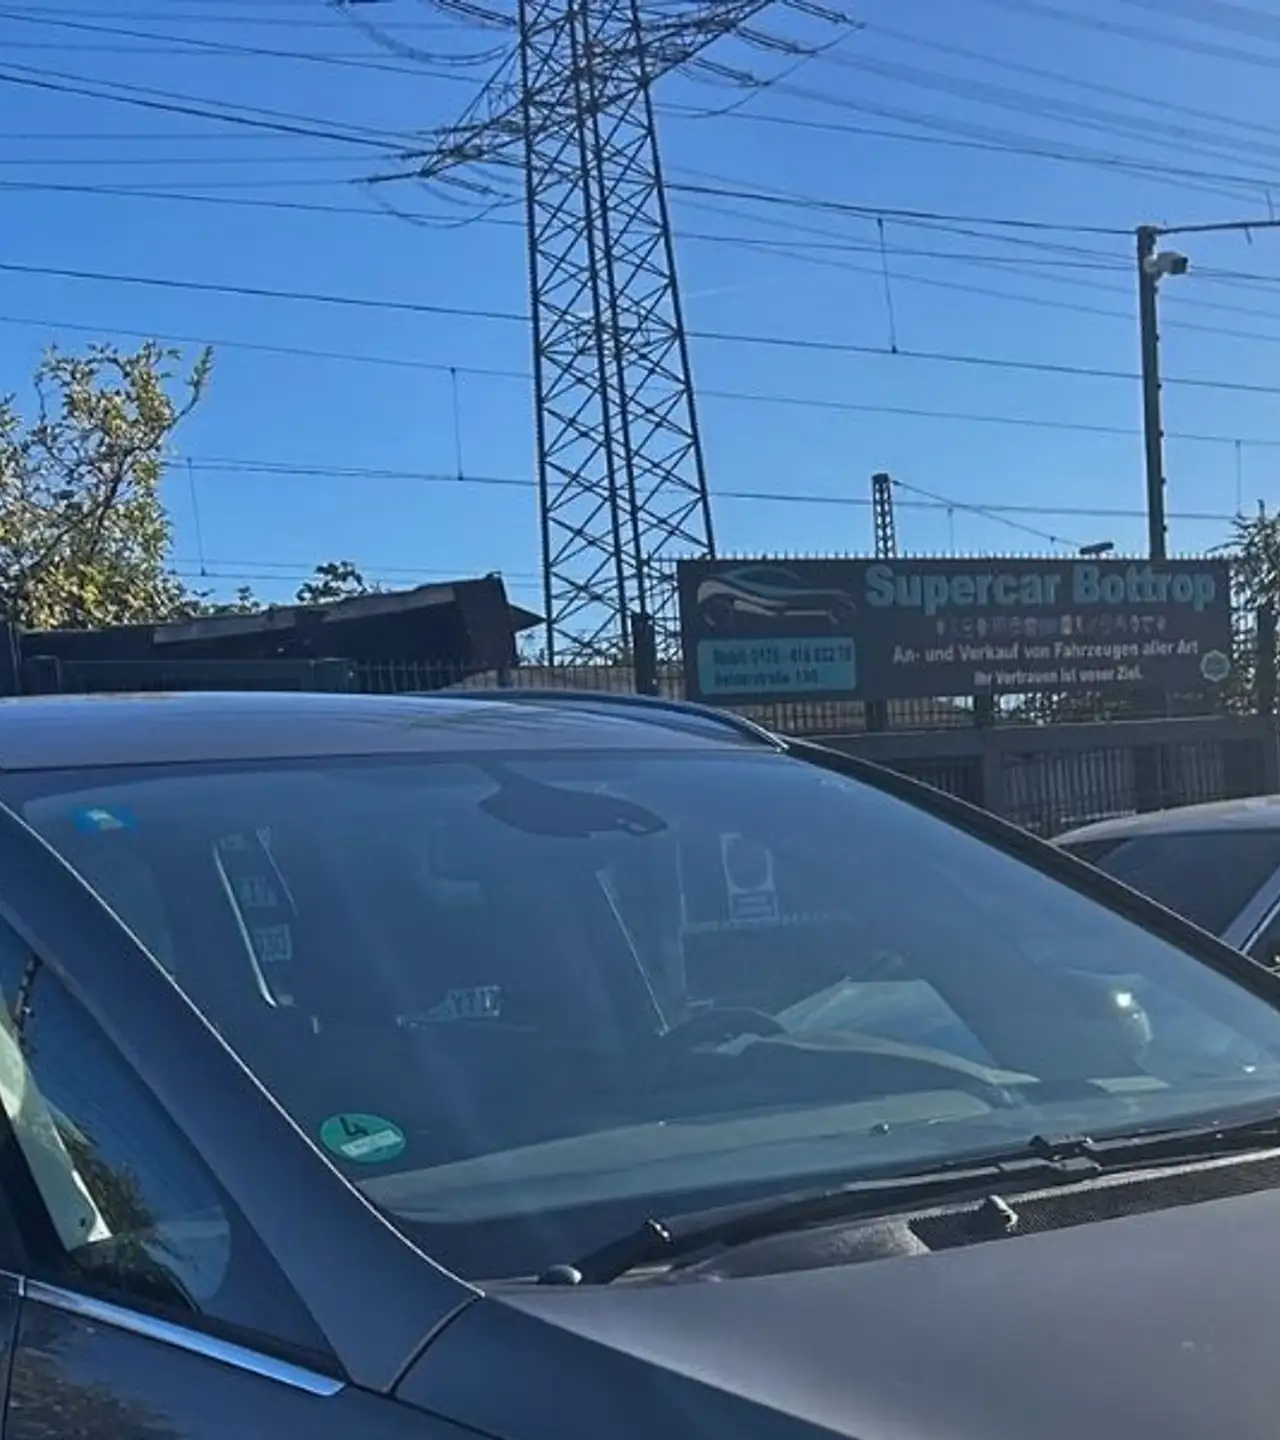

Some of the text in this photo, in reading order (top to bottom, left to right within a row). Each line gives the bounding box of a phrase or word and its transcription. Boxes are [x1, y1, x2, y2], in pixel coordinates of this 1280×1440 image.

[865, 562, 1215, 615] Supercar Bottrop
[925, 644, 954, 662] und
[959, 642, 1019, 661] Verkauf
[1024, 645, 1049, 659] von
[1054, 641, 1138, 660] Fahrzeugen
[1143, 639, 1173, 655] aller
[1176, 638, 1199, 655] Art
